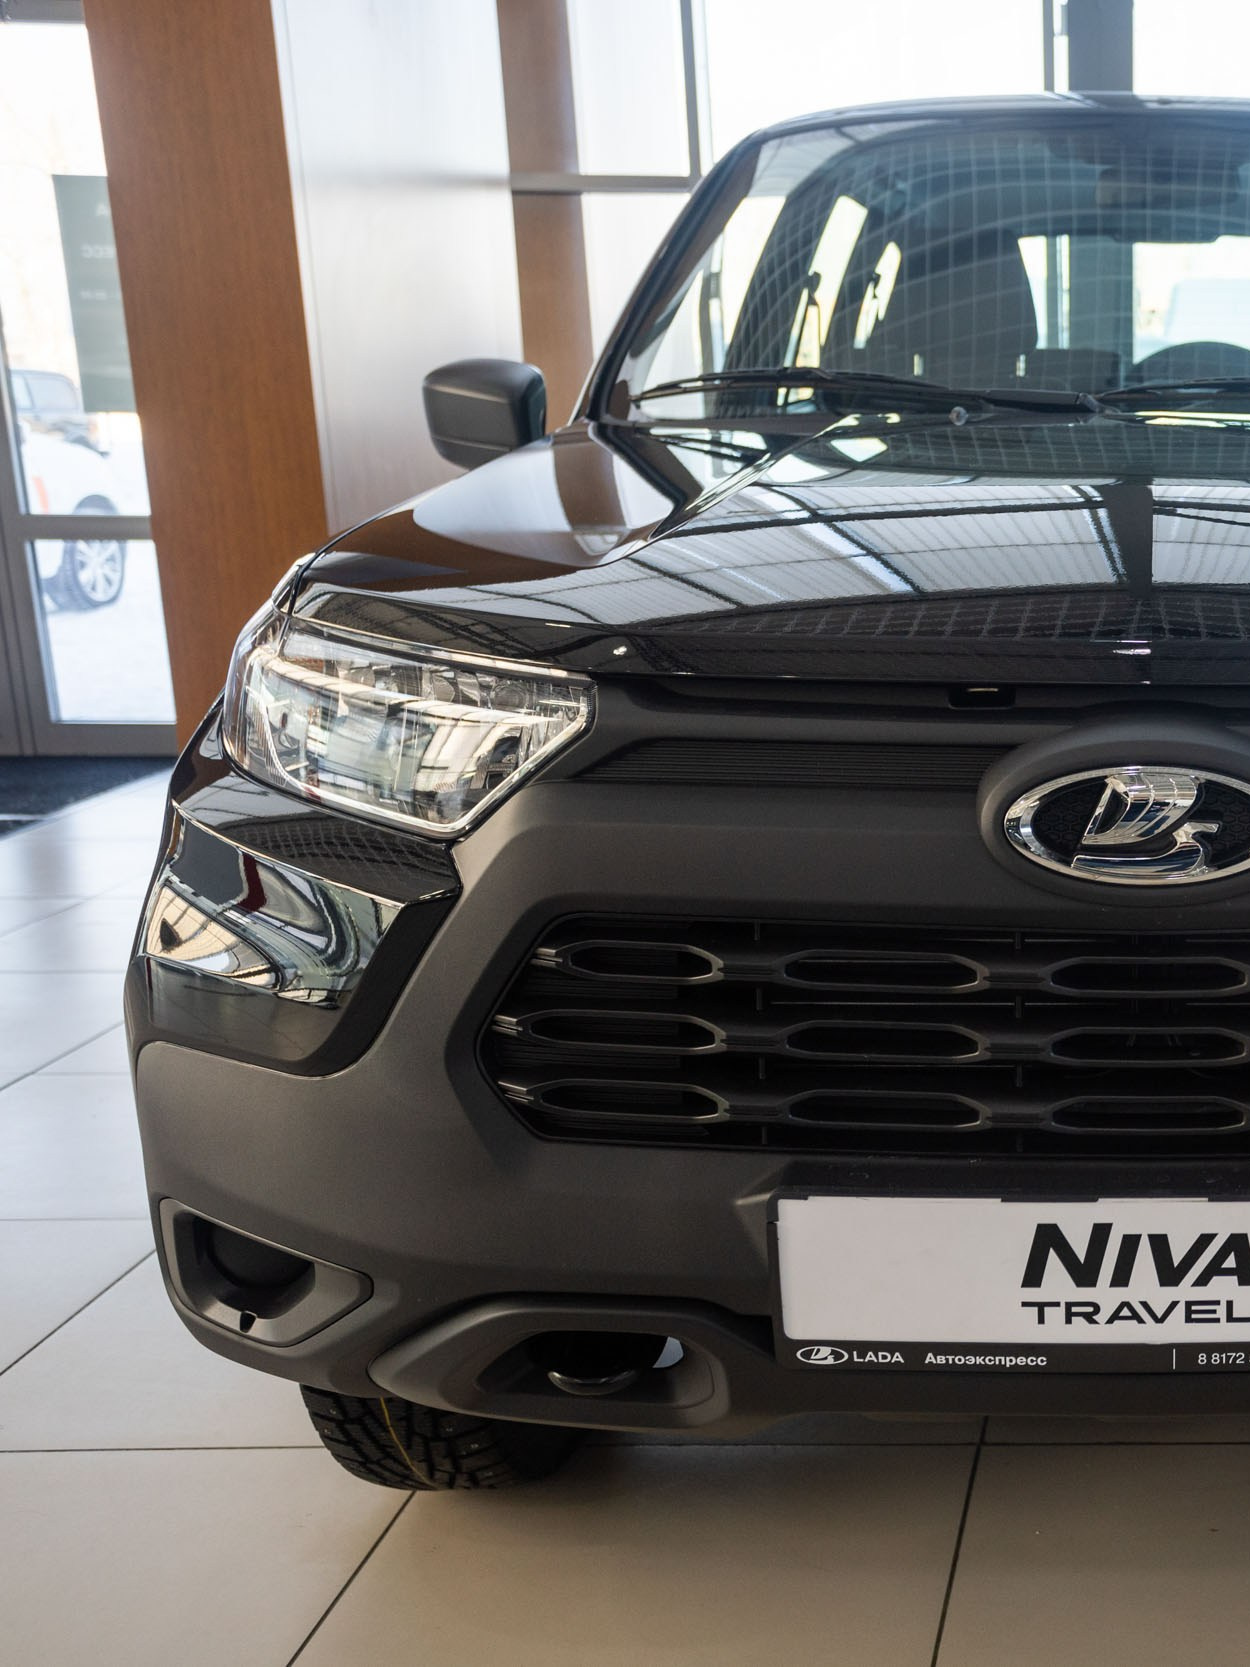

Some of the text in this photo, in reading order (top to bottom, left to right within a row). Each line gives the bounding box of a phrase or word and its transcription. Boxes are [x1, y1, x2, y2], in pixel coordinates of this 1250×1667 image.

[851, 1350, 906, 1364] LADA
[923, 1352, 1048, 1368] Автоэкспресс
[1197, 1352, 1208, 1366] 8
[1211, 1352, 1246, 1365] 8172
